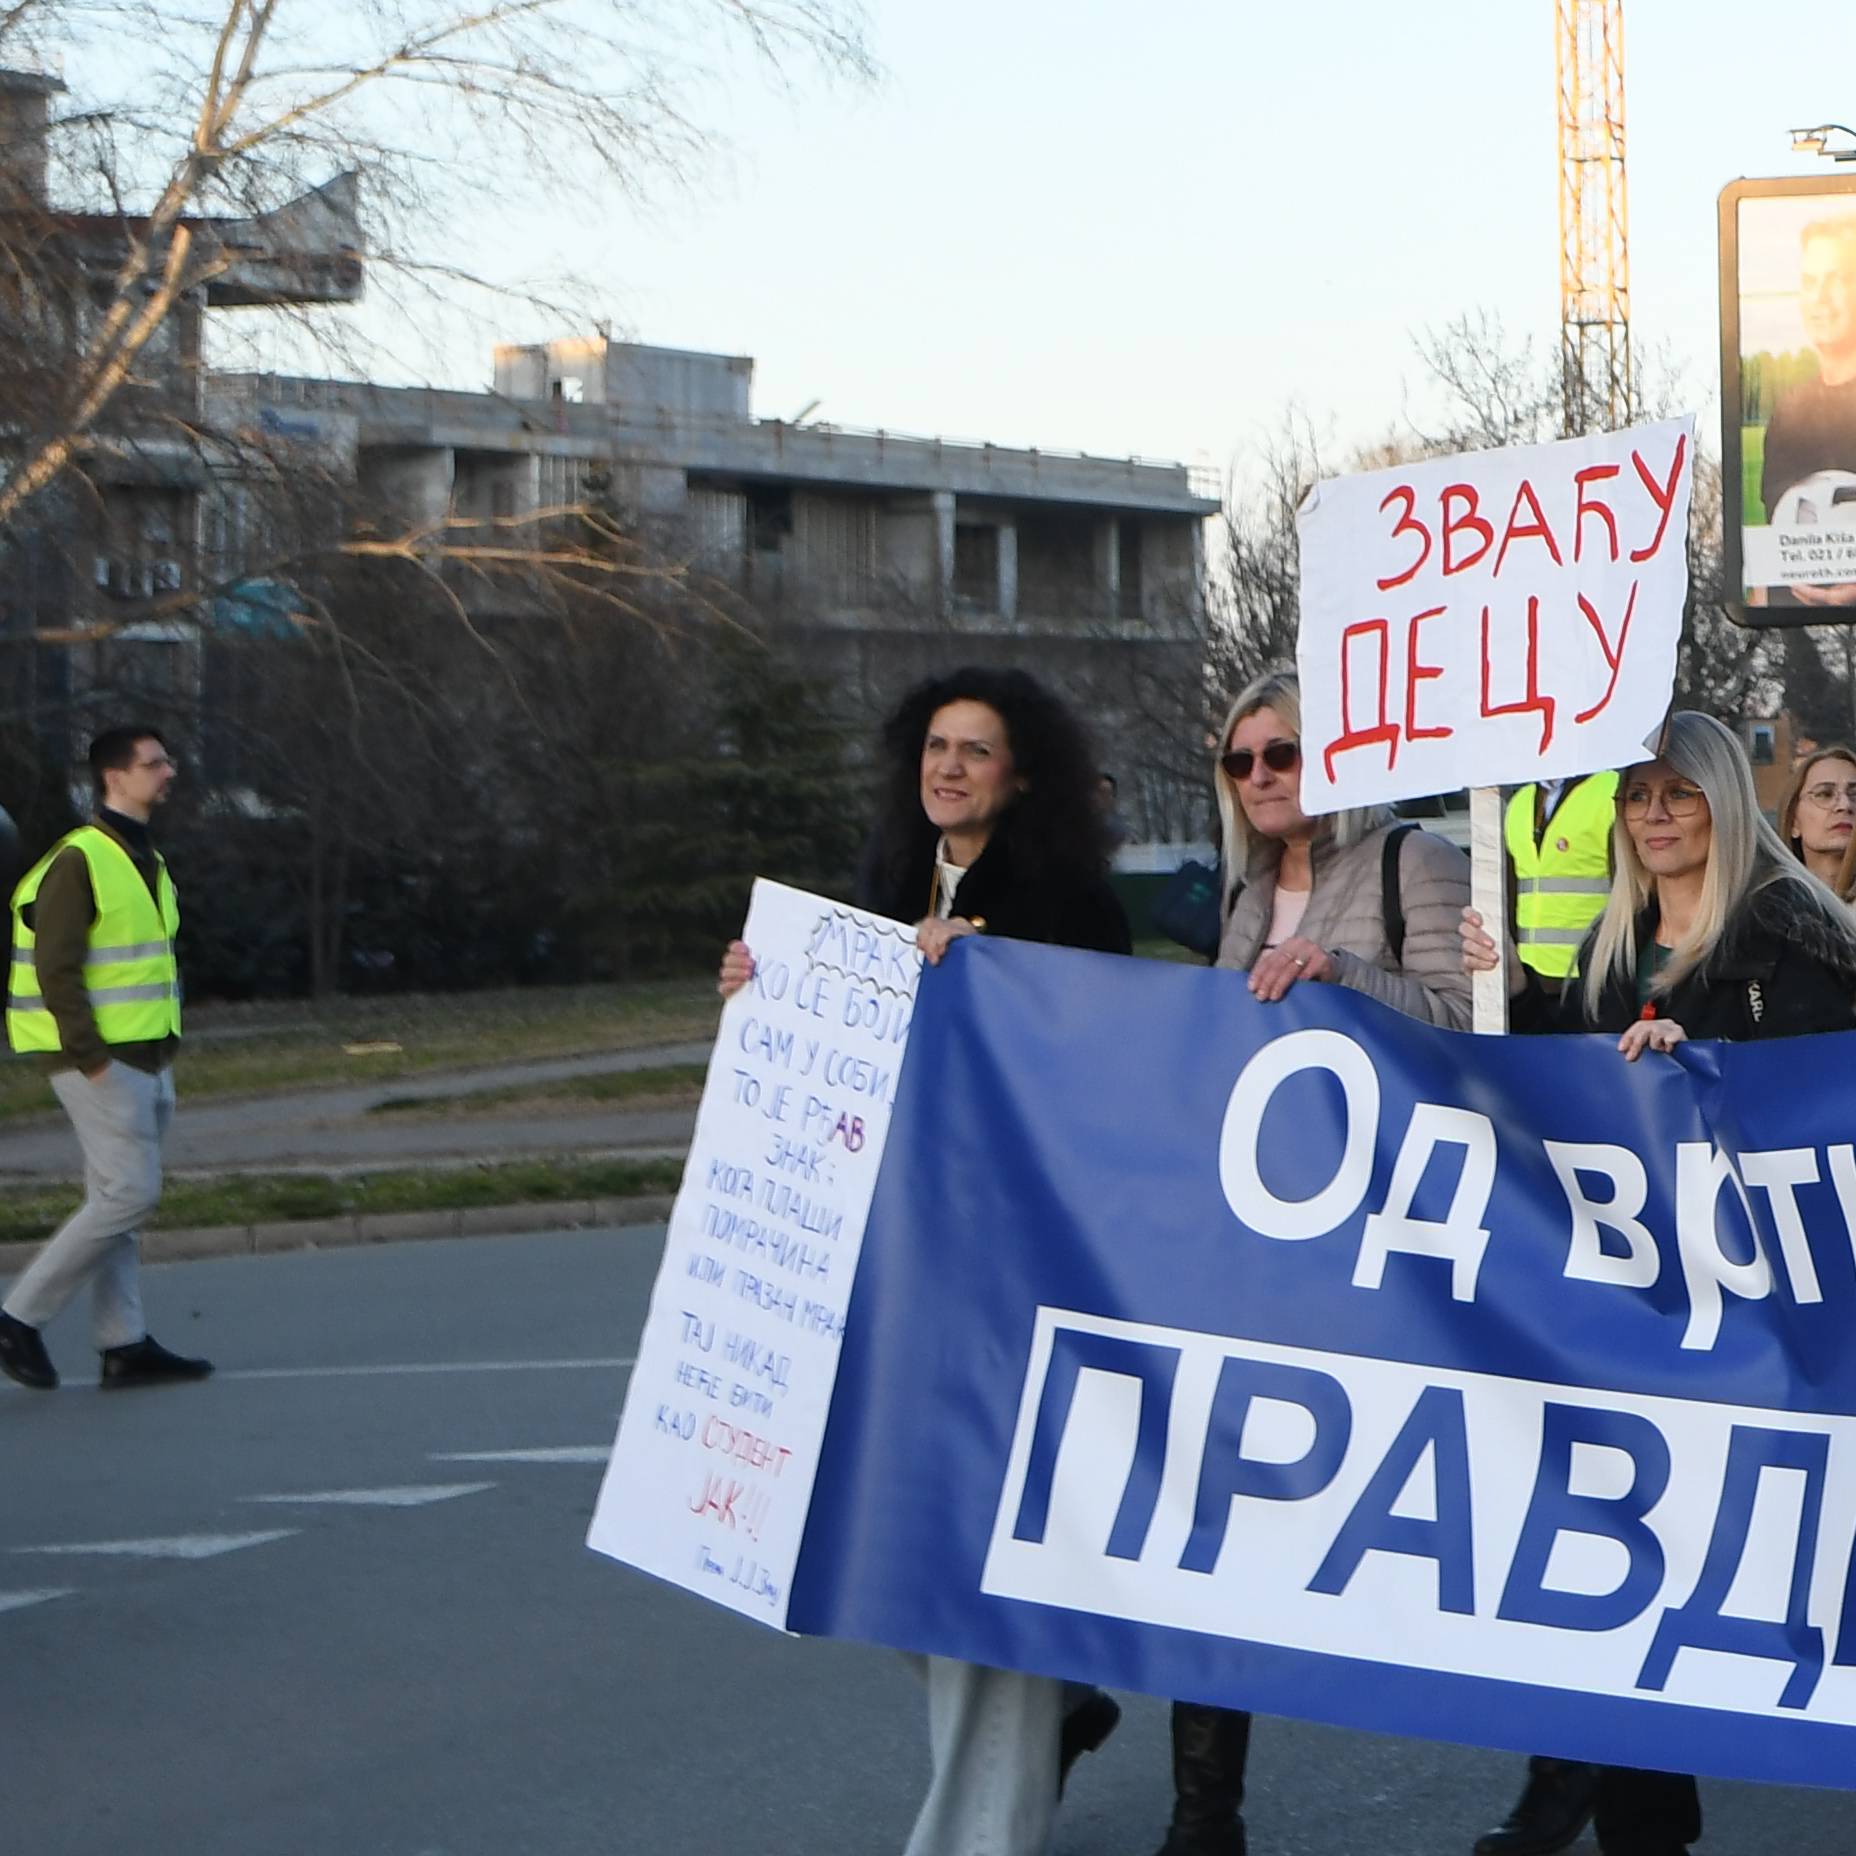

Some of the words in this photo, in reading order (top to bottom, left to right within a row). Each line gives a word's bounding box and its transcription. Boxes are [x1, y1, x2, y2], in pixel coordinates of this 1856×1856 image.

[1377, 433, 1687, 591] ЗВАЋУ
[1322, 579, 1639, 785] ДЕЦУ
[752, 953, 790, 1001] КО
[794, 973, 830, 1019] СЕ
[814, 918, 911, 986] МРАК
[740, 1018, 794, 1068] САМ
[799, 1040, 820, 1076] У
[733, 1069, 761, 1108] ТО
[762, 1084, 793, 1122] ЈЕ
[1217, 1028, 1499, 1304] Од
[703, 1203, 831, 1283] ПОМРАЧИНА
[681, 1310, 716, 1353] ТАЈ
[655, 1403, 696, 1441] КАО
[702, 1414, 793, 1478] СТУДЕНТ
